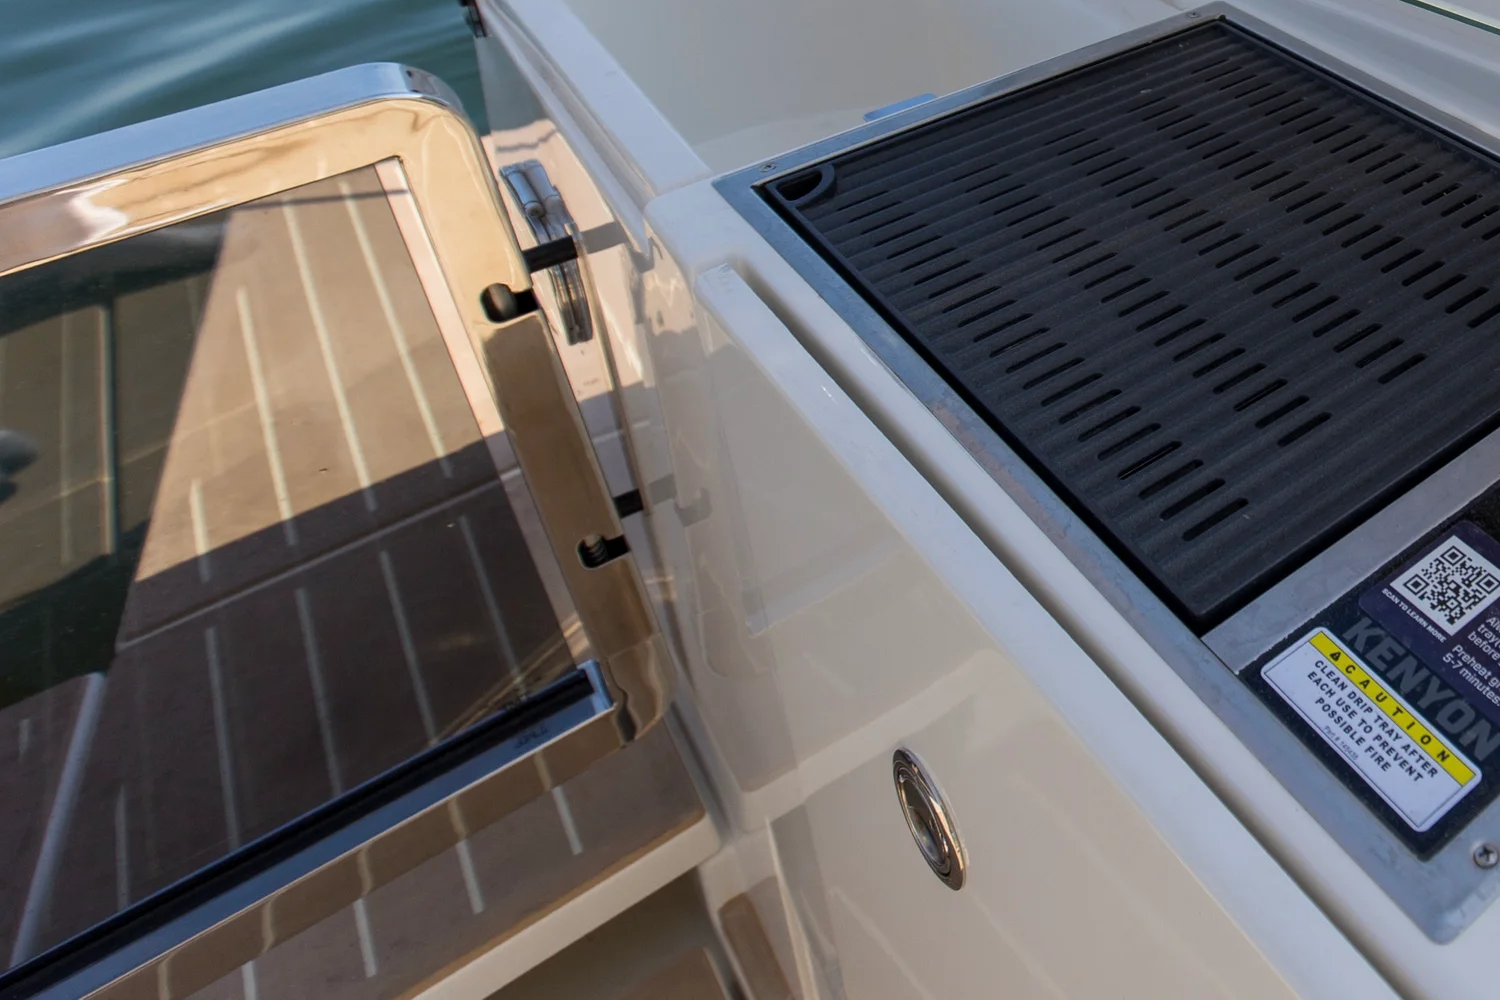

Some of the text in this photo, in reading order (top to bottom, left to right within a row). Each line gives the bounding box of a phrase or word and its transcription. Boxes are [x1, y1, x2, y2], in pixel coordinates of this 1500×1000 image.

[1382, 588, 1446, 643] SCAN TO LEARN MORE
[1468, 631, 1500, 660] before
[1443, 652, 1500, 707] 5-7 minutes.
[1452, 645, 1492, 679] Preheat
[1307, 671, 1424, 782] EACH USE TO PREVENT
[1315, 660, 1438, 778] CLEAN DRIP TRAY AFTER
[1315, 697, 1391, 772] POSSIBLE FIRE
[1345, 664, 1450, 762] CAUTION
